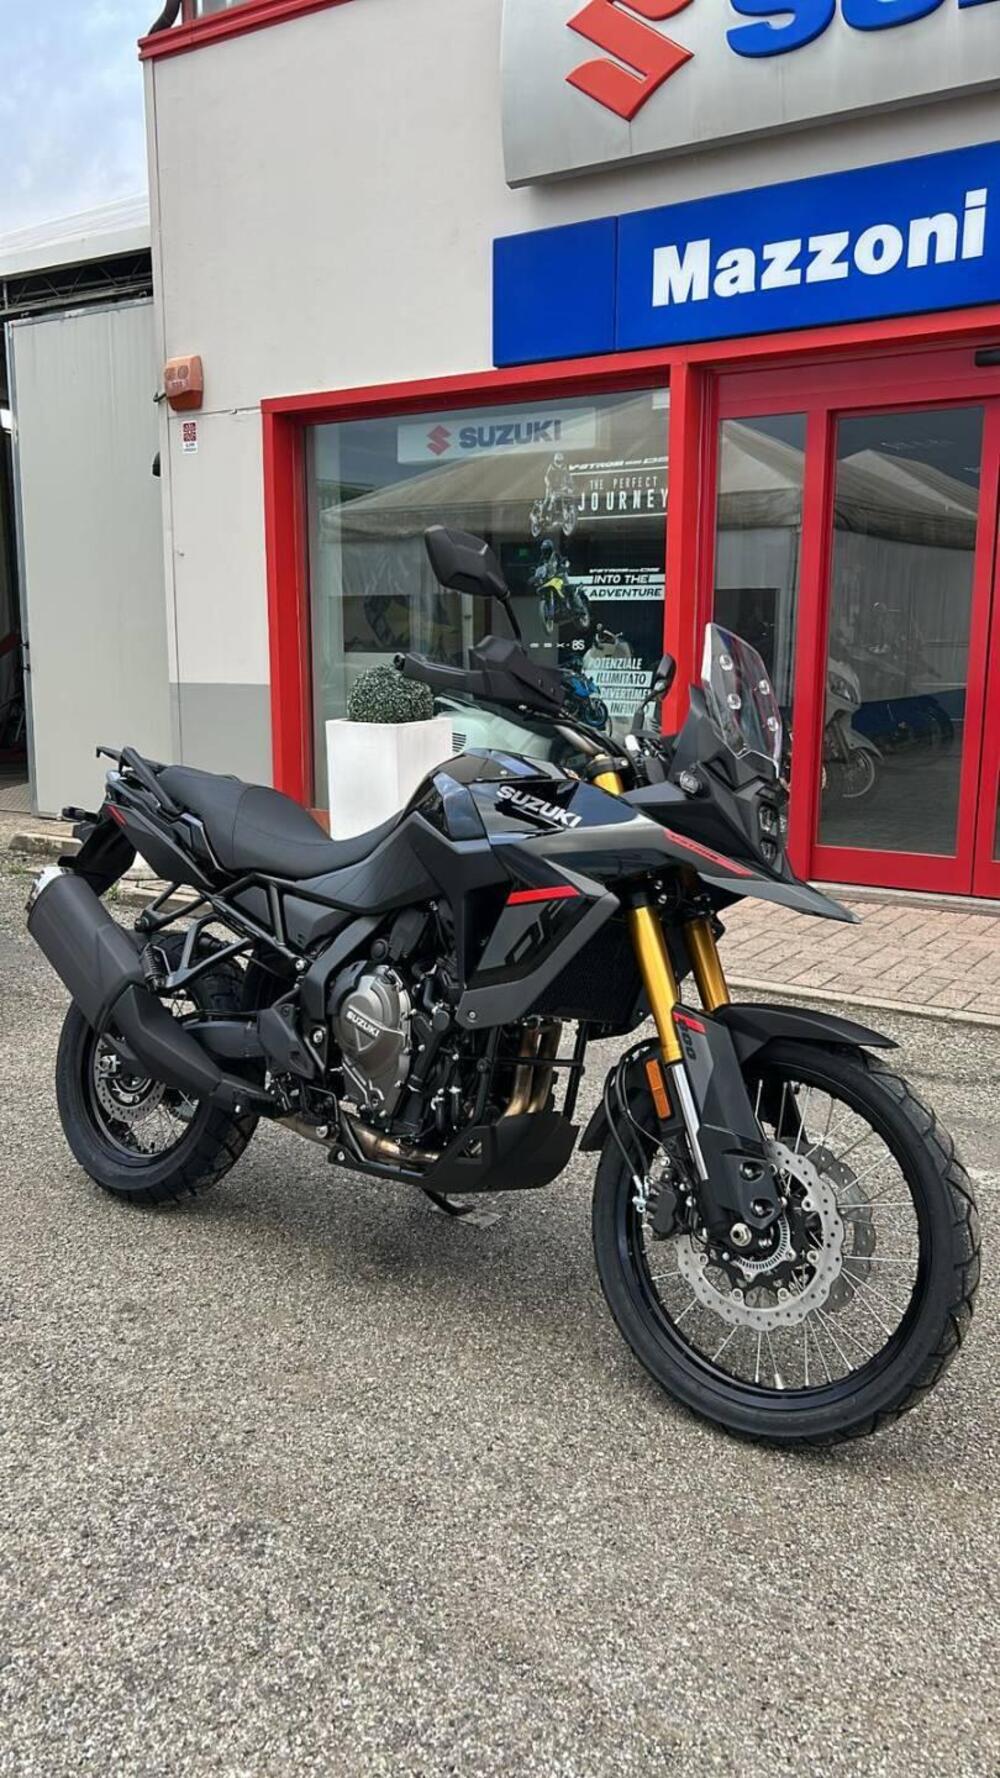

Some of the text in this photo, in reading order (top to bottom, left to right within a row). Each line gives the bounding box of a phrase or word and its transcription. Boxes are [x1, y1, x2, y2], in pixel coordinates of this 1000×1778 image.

[652, 188, 988, 307] Mazzoni
[459, 419, 562, 449] SUZUKI
[590, 476, 657, 490] THE PERFECT
[577, 488, 669, 511] JOURNEY
[593, 574, 649, 584] INTO THE
[589, 587, 663, 598] ADVENTURE
[596, 671, 647, 685] ILLIMITATO
[496, 785, 583, 828] SUZUKI
[346, 1010, 380, 1037] SUZUKI
